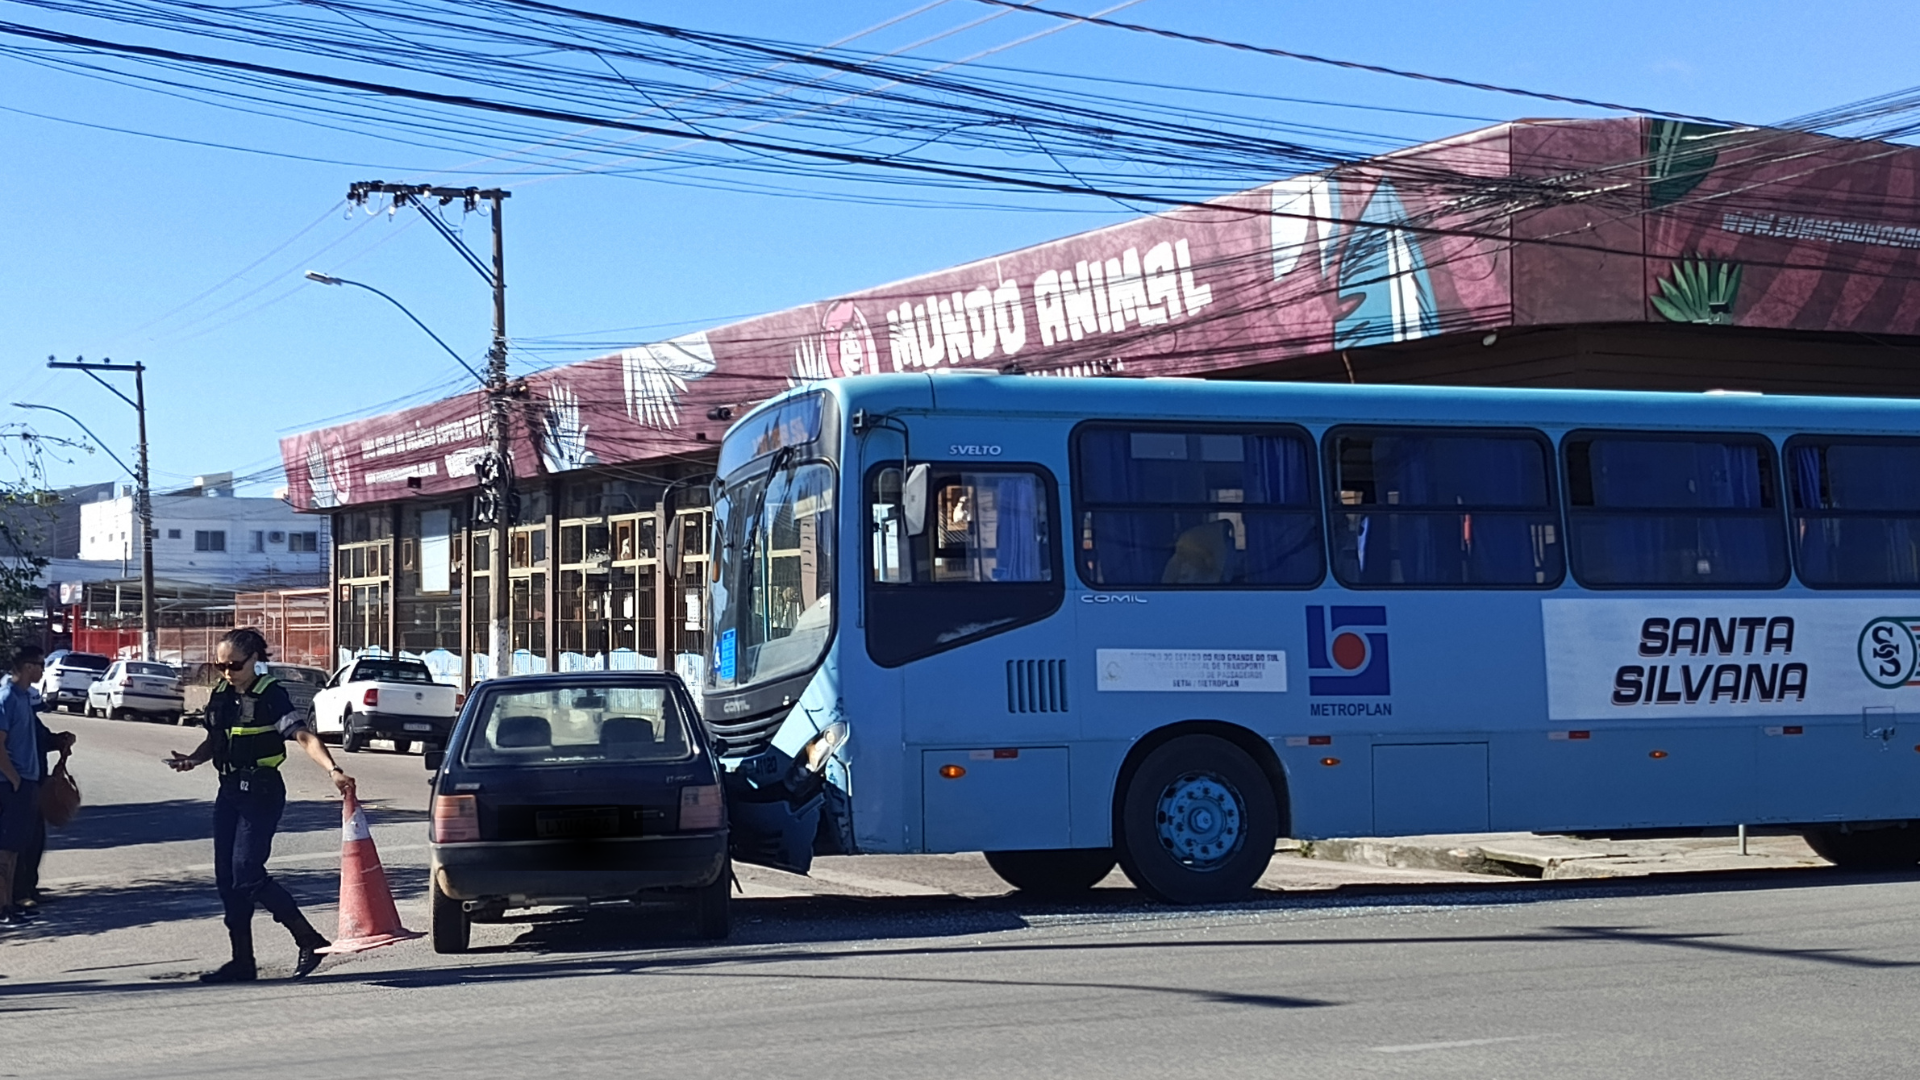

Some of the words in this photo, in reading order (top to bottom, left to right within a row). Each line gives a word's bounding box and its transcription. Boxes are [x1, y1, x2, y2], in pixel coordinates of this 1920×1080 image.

[886, 279, 1026, 371] MUNDO
[1034, 238, 1213, 346] ANIMAL
[949, 445, 1002, 456] SVELTO
[1081, 594, 1148, 604] COMIL
[1638, 616, 1795, 656] SANTA
[1203, 653, 1212, 661] DO
[1214, 653, 1225, 661] RIO
[1227, 653, 1254, 661] GRANDE
[1267, 654, 1279, 662] SUL
[1212, 662, 1220, 670] DE
[1223, 662, 1266, 670] TRANSPORTE
[1610, 662, 1808, 706] SILVANA
[1310, 702, 1392, 717] METROPLAN
